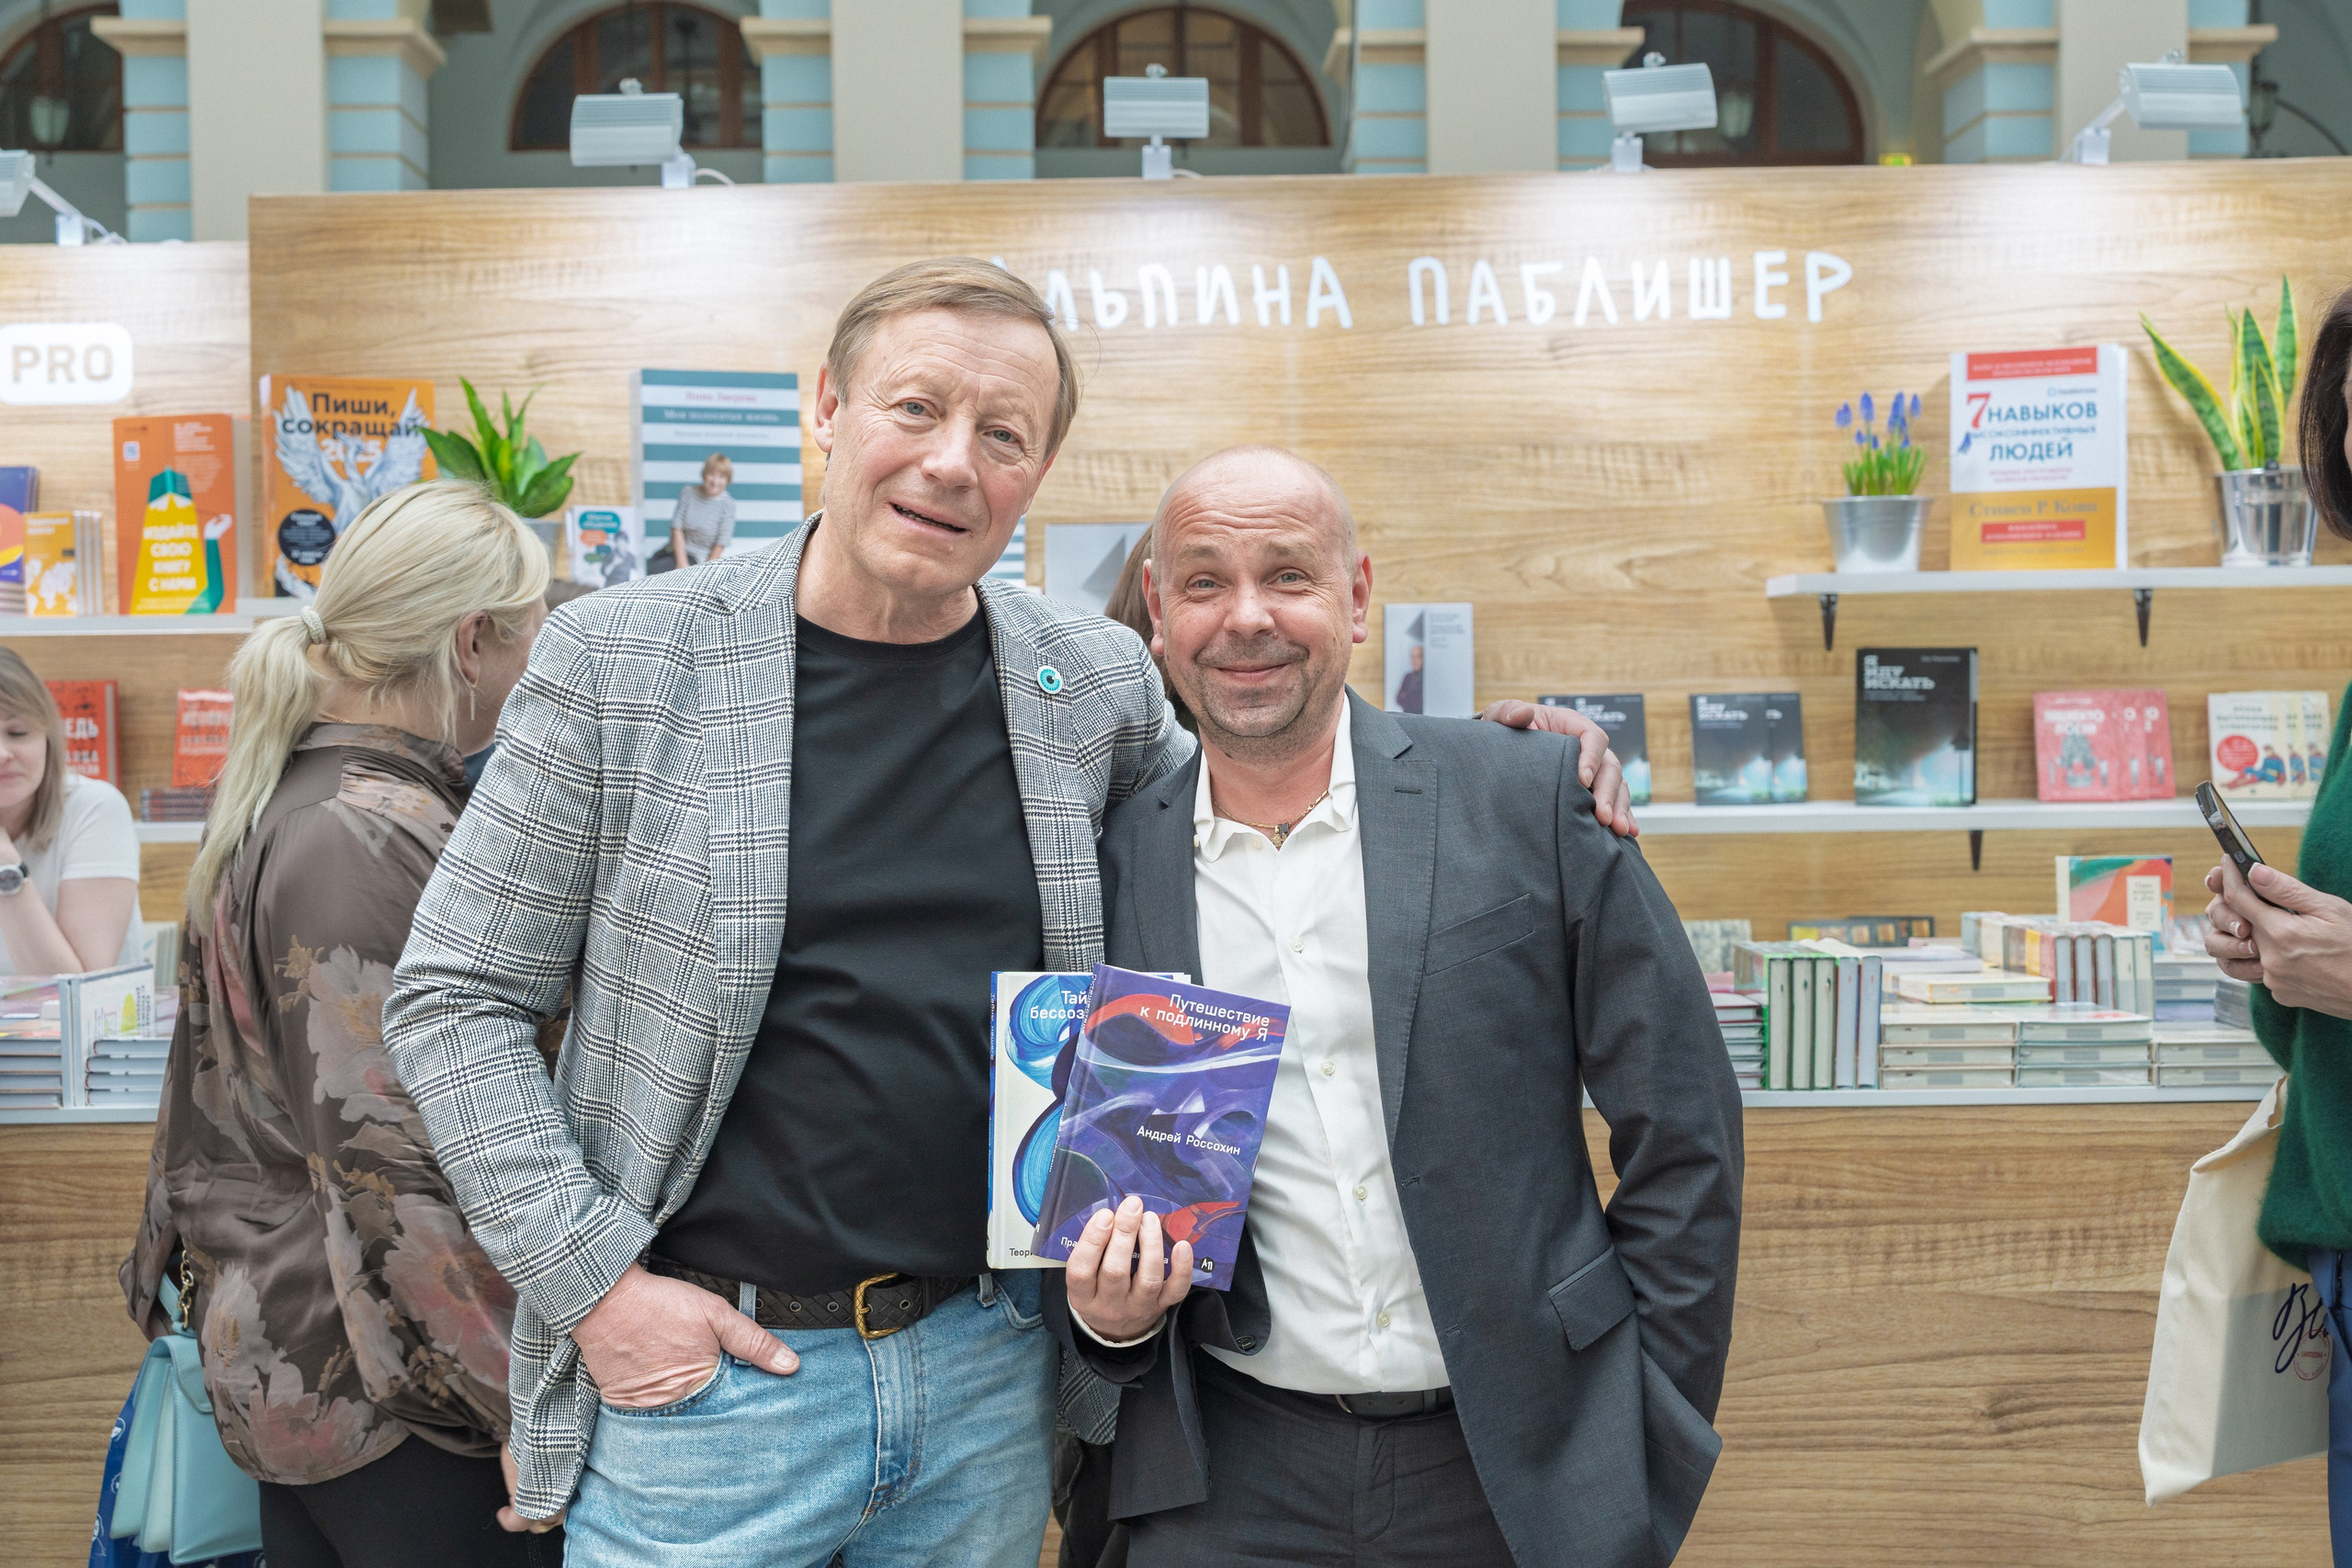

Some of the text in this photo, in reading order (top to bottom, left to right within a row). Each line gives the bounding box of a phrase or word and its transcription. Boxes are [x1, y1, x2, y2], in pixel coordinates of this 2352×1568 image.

[990, 250, 1854, 333] ЛЬПИНА ПАБЛИШЕР
[11, 344, 114, 384] PRO
[311, 393, 396, 418] Пиши,
[1966, 392, 2098, 429] 7 НАВЫКОВ
[1989, 438, 2073, 462] ЛЮДЕЙ
[1863, 677, 1936, 690] ИСКАТЬ
[1156, 1010, 1250, 1041] подлинному
[1256, 1027, 1269, 1042] Я
[1169, 993, 1271, 1028] Путешествие
[1136, 1125, 1241, 1156] Андрей Россохин
[1009, 1247, 1033, 1258] Теор
[1060, 1236, 1078, 1247] Пра
